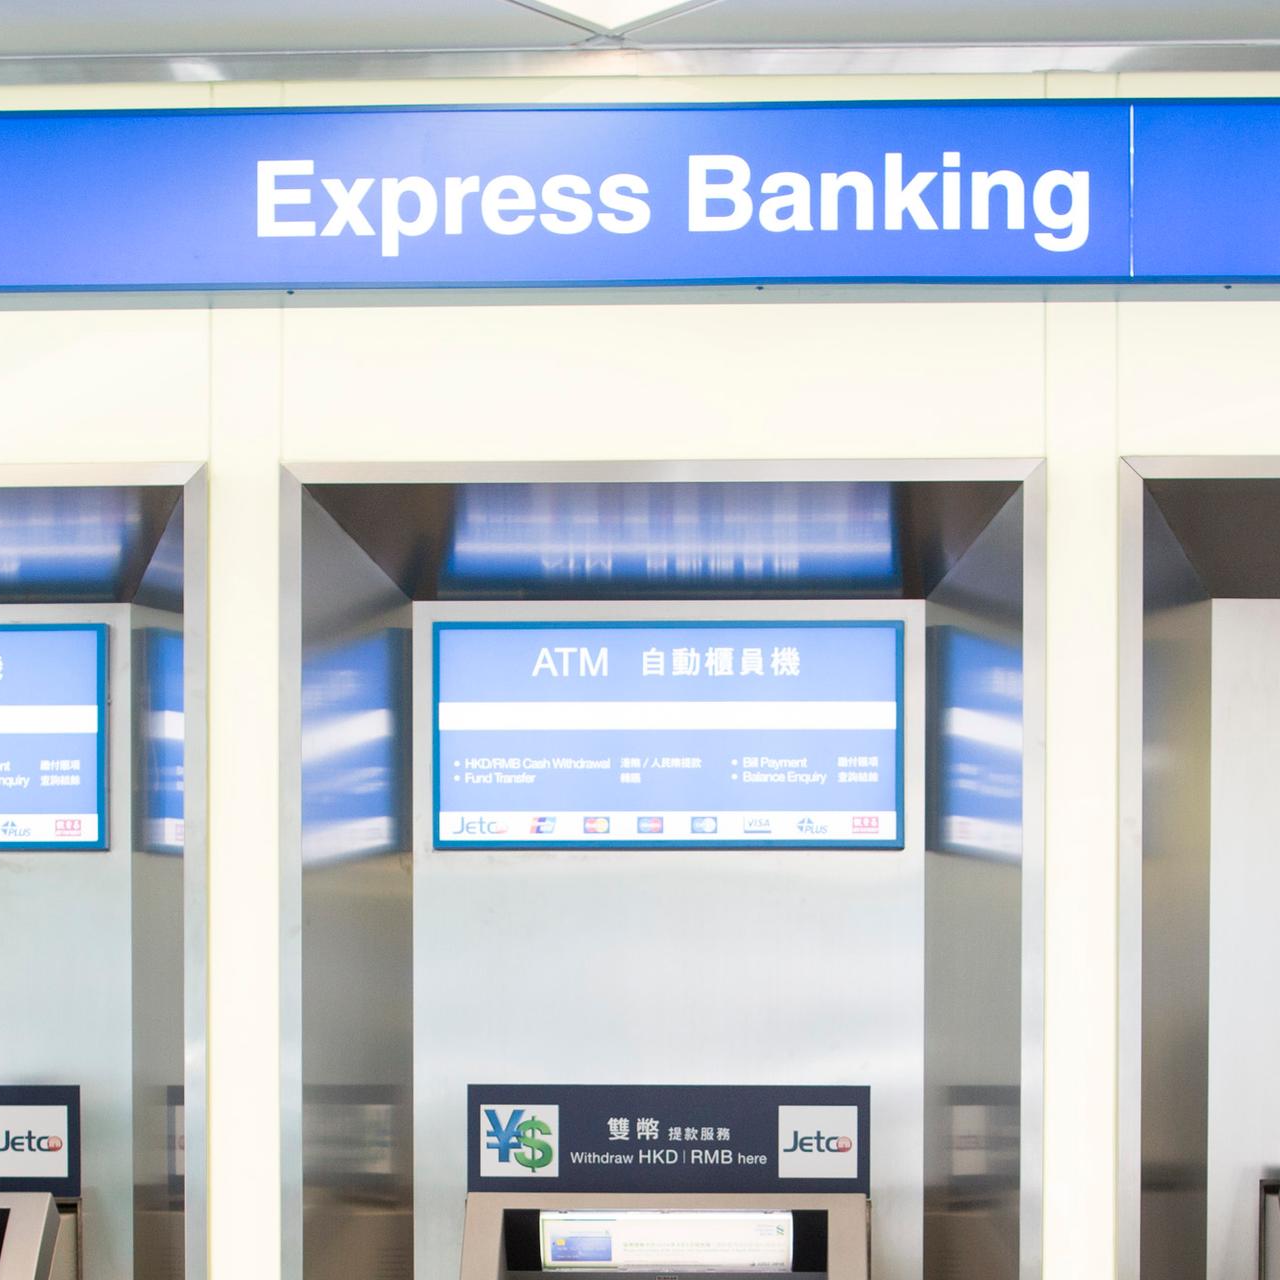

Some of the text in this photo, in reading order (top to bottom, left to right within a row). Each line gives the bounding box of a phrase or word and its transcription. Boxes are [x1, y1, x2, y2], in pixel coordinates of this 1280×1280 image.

[257, 152, 1092, 256] Express Banking
[532, 646, 800, 677] ATM 自動櫃員機
[522, 757, 550, 769] Cash
[552, 757, 610, 769] Withdrawal
[743, 757, 807, 770] Bill Payment
[464, 772, 536, 783] Fund Transfer
[743, 772, 827, 785] Balance Enquiry
[783, 1130, 853, 1153] Jetco
[570, 1149, 768, 1165] Withdraw HKD RMB here
